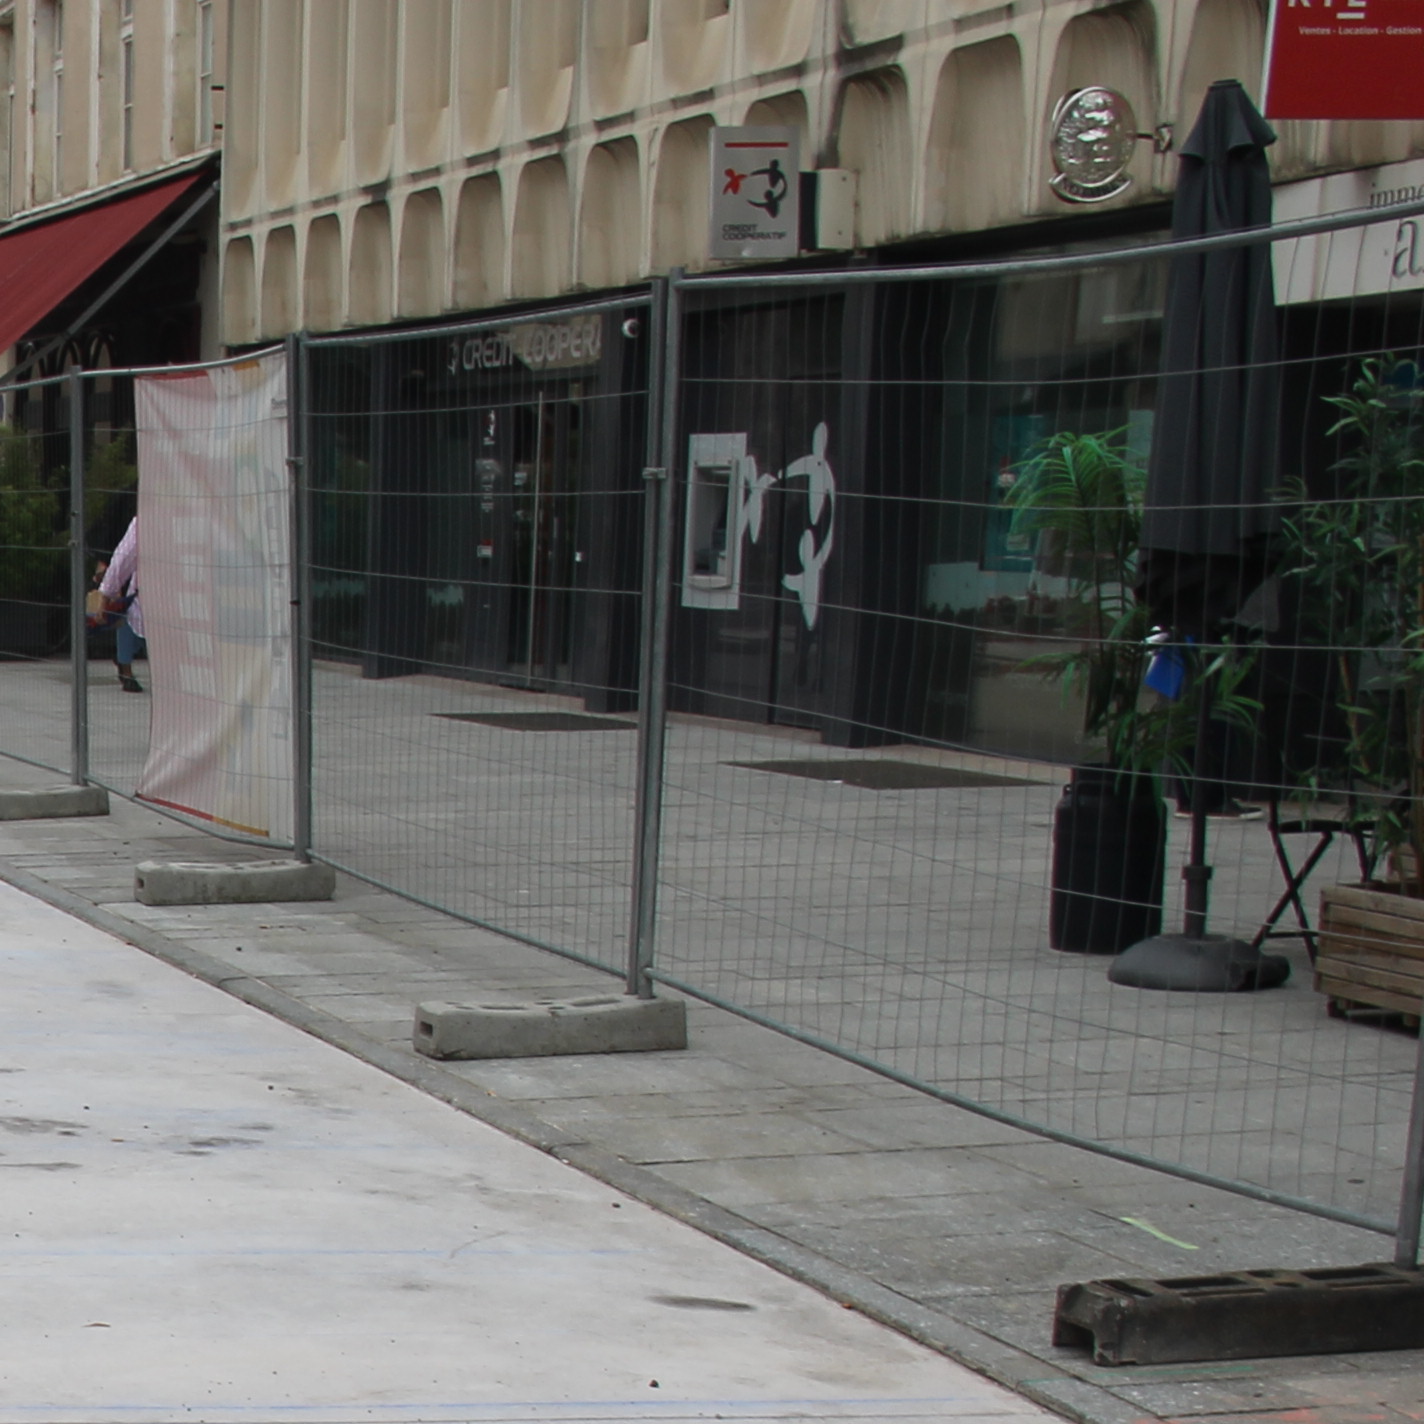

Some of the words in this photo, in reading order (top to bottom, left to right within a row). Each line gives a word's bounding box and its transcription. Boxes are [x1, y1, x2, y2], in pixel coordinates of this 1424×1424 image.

[1298, 25, 1331, 36] Ventes
[1338, 25, 1378, 36] Location
[1385, 25, 1422, 36] Gestion
